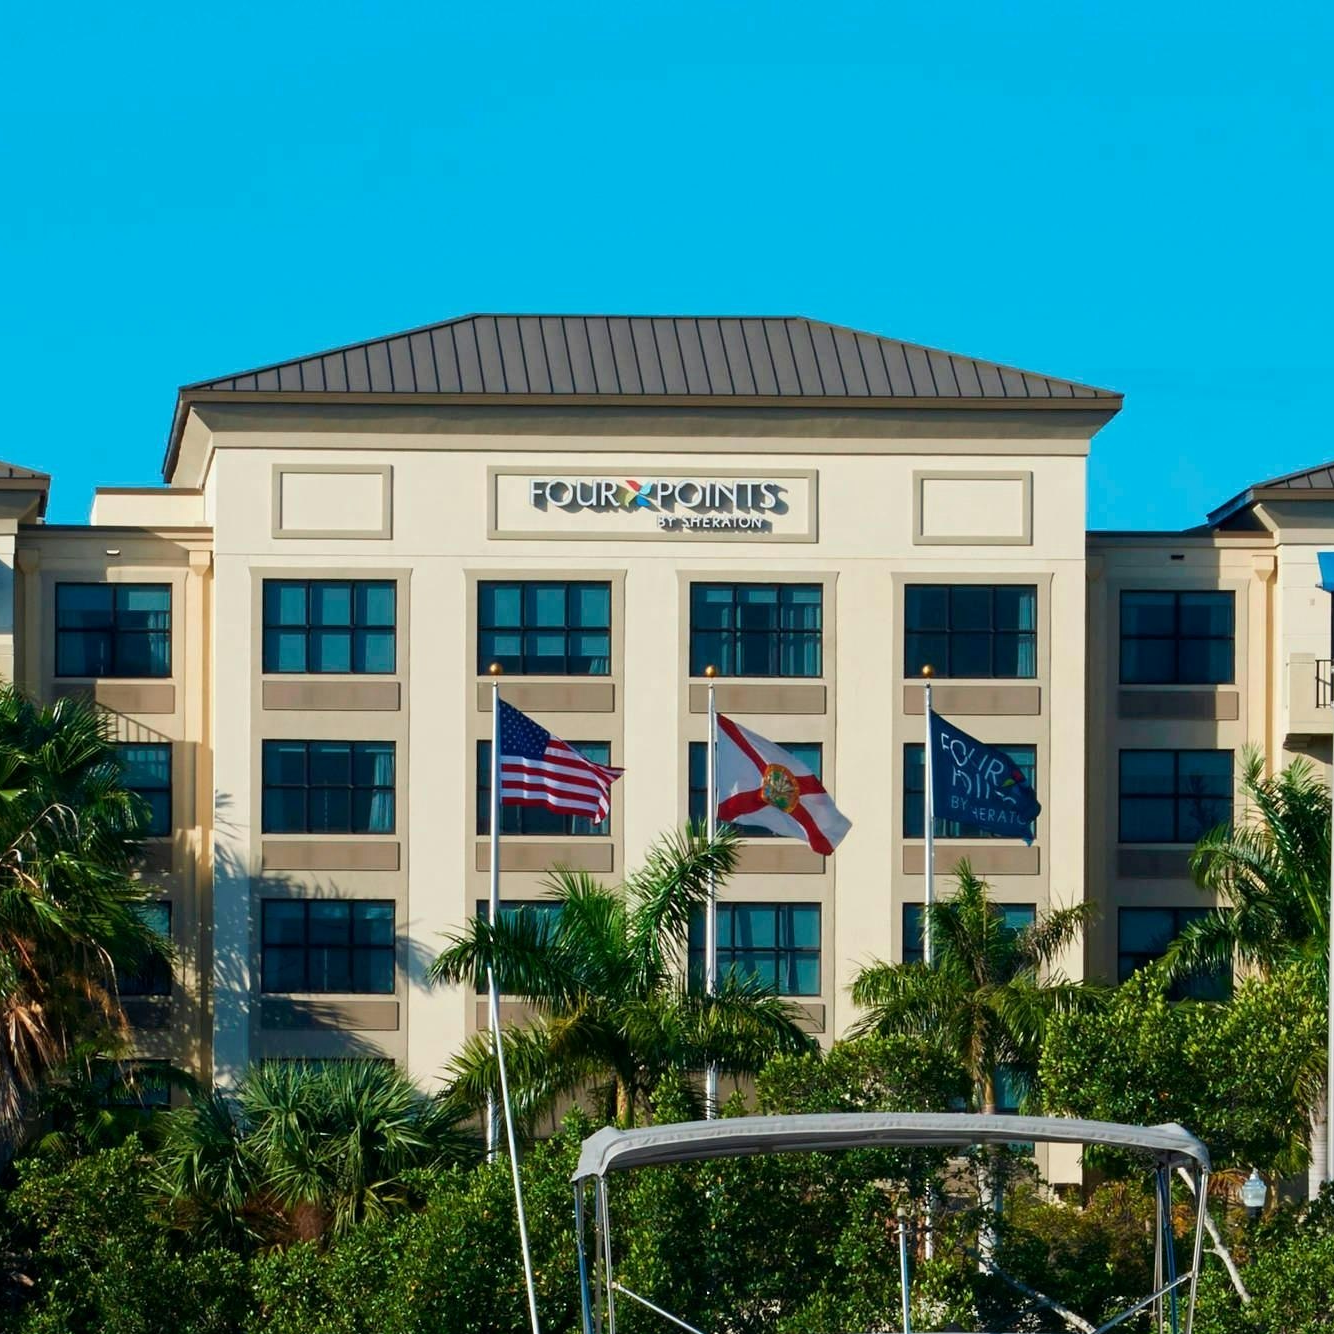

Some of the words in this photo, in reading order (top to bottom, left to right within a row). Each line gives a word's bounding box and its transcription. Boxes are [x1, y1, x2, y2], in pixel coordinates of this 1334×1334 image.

[529, 478, 621, 508] FOUR
[656, 479, 777, 510] POINTS
[656, 514, 676, 528] BY
[680, 515, 763, 529] SHERATON
